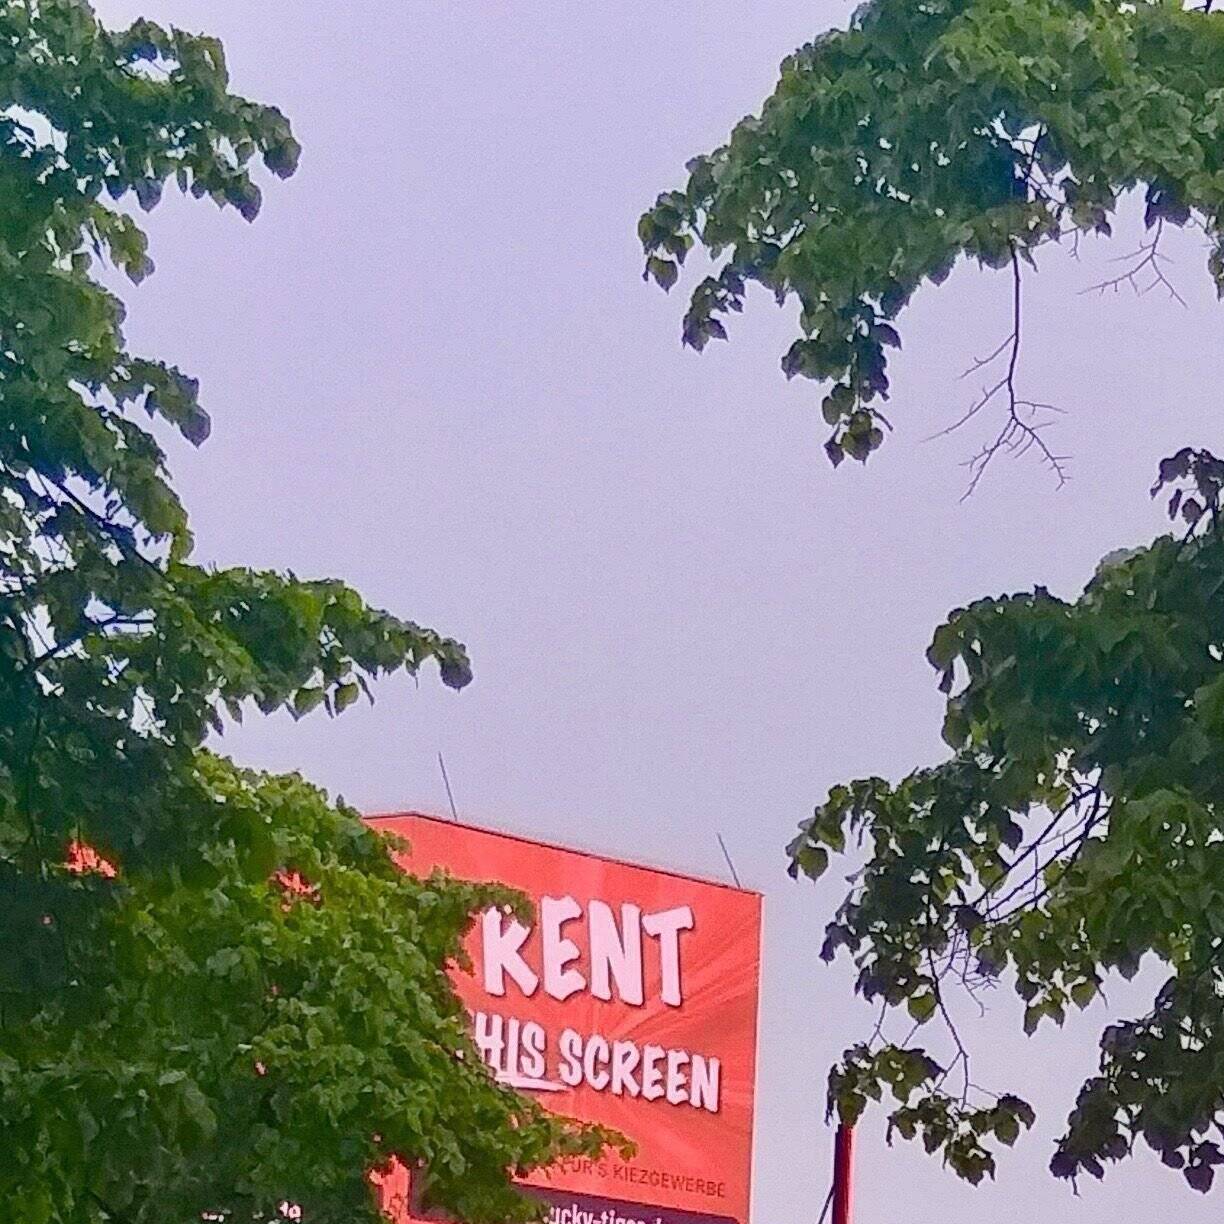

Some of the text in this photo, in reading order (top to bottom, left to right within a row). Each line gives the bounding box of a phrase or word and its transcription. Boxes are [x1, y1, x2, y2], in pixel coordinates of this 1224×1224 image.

[475, 1011, 721, 1114] HIS SCREEN
[613, 1163, 726, 1198] KIEZGEWERBE
